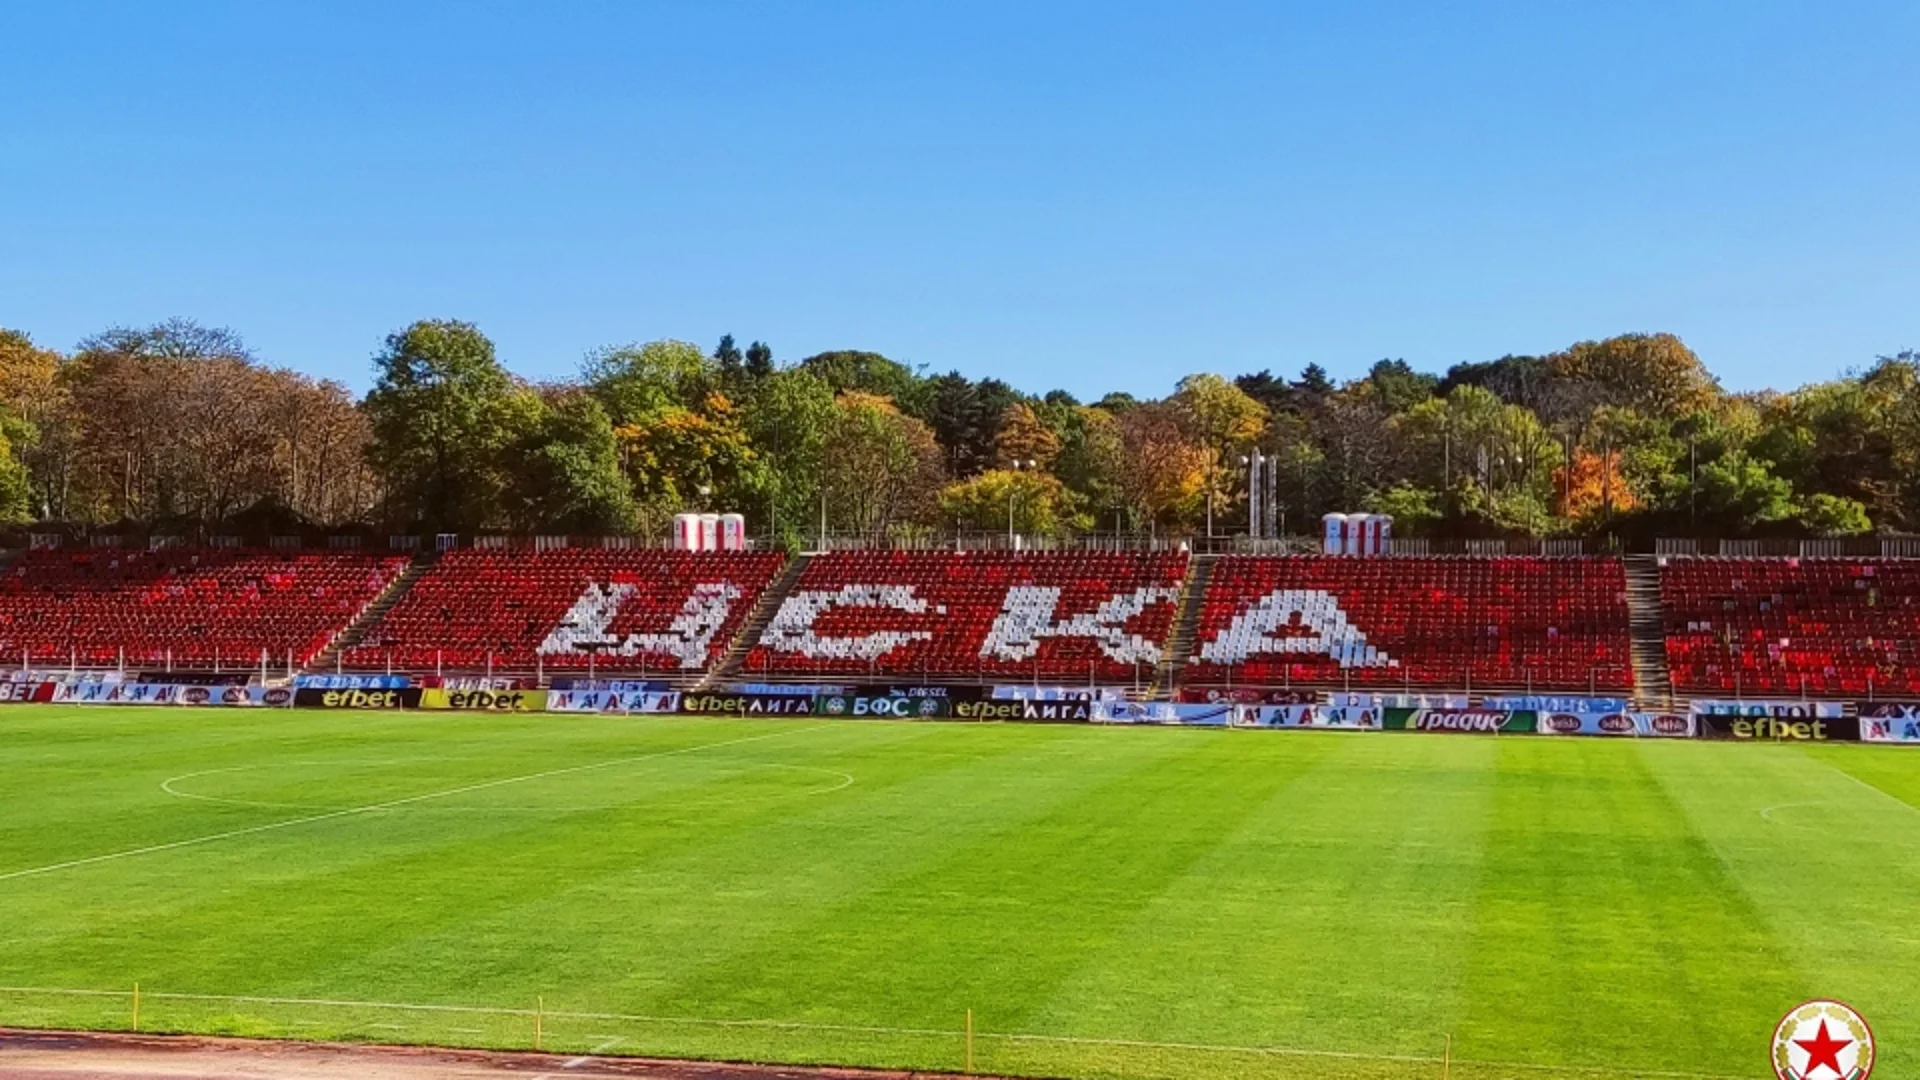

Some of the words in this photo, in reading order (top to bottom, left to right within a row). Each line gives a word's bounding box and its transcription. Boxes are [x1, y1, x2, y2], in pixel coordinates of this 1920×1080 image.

[536, 582, 1399, 670] ЦСКА
[322, 688, 397, 707] efbet
[448, 691, 524, 709] efbet
[684, 694, 747, 711] efbet
[853, 697, 911, 716] БФС
[956, 701, 1021, 717] efbet
[1416, 709, 1506, 731] Градус
[1729, 717, 1828, 739] efbet
